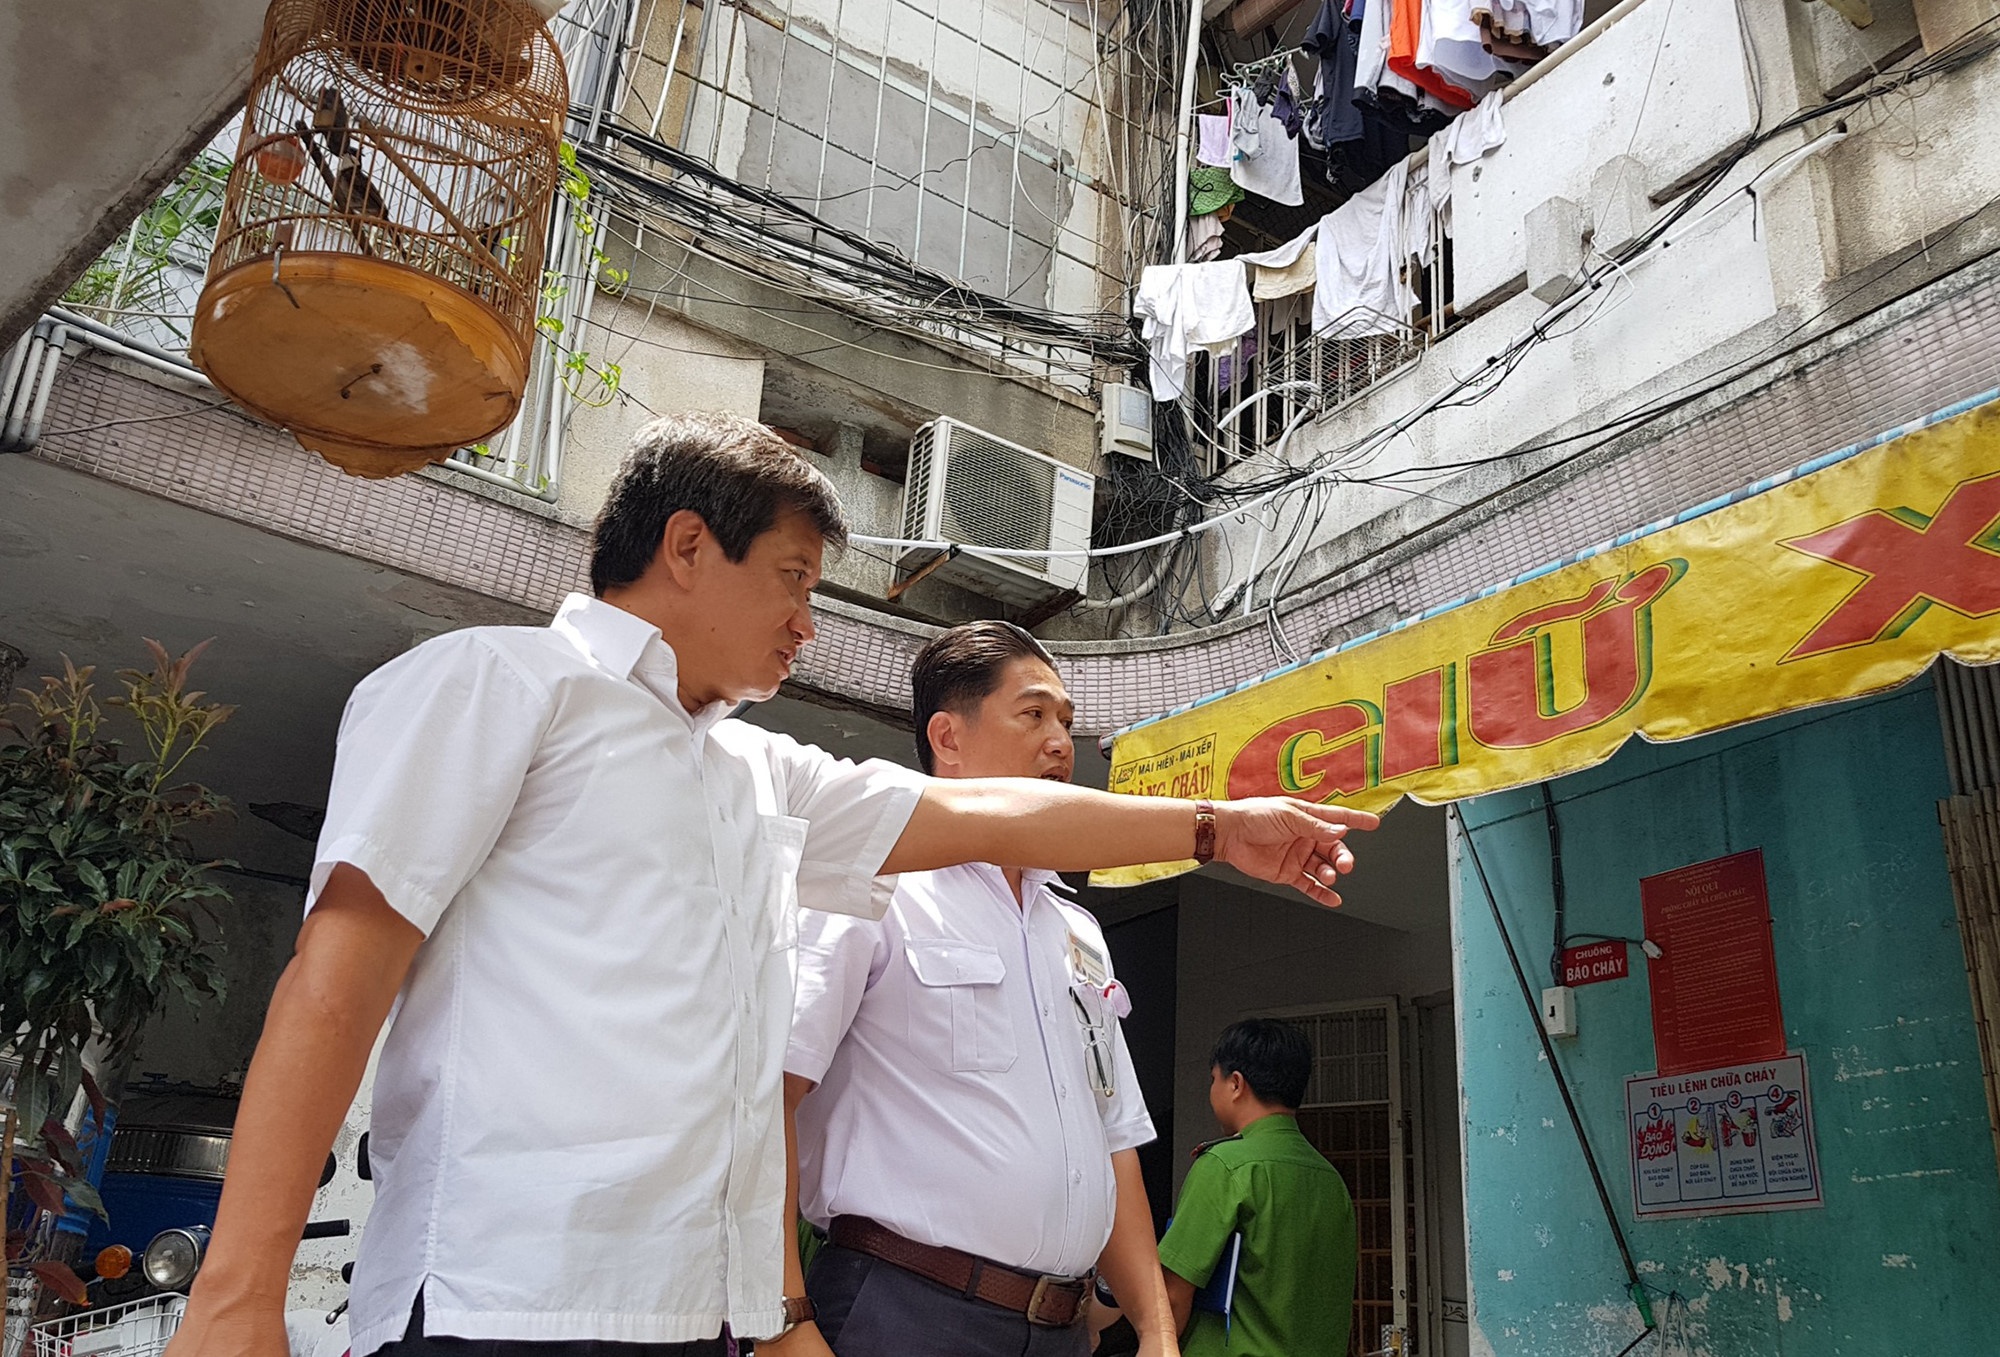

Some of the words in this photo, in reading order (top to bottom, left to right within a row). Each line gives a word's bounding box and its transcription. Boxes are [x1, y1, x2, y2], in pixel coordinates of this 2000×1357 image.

[1225, 558, 1688, 802] GIỮ
[1138, 760, 1154, 775] MÁI
[1180, 746, 1194, 762] MÁI
[1171, 762, 1210, 798] CHÂU
[1575, 946, 1612, 959] CHUÔNG
[1566, 962, 1590, 981] BÁO
[1592, 956, 1623, 976] CHÁY
[1650, 1082, 1675, 1098] TIÊU
[1678, 1078, 1707, 1095] LỆNH
[1711, 1072, 1741, 1088] CHỮA
[1744, 1067, 1777, 1083] CHÁY
[1730, 1093, 1739, 1105] 3
[1770, 1088, 1780, 1099] 4
[1651, 1105, 1658, 1116] 1
[1690, 1101, 1697, 1111] 2
